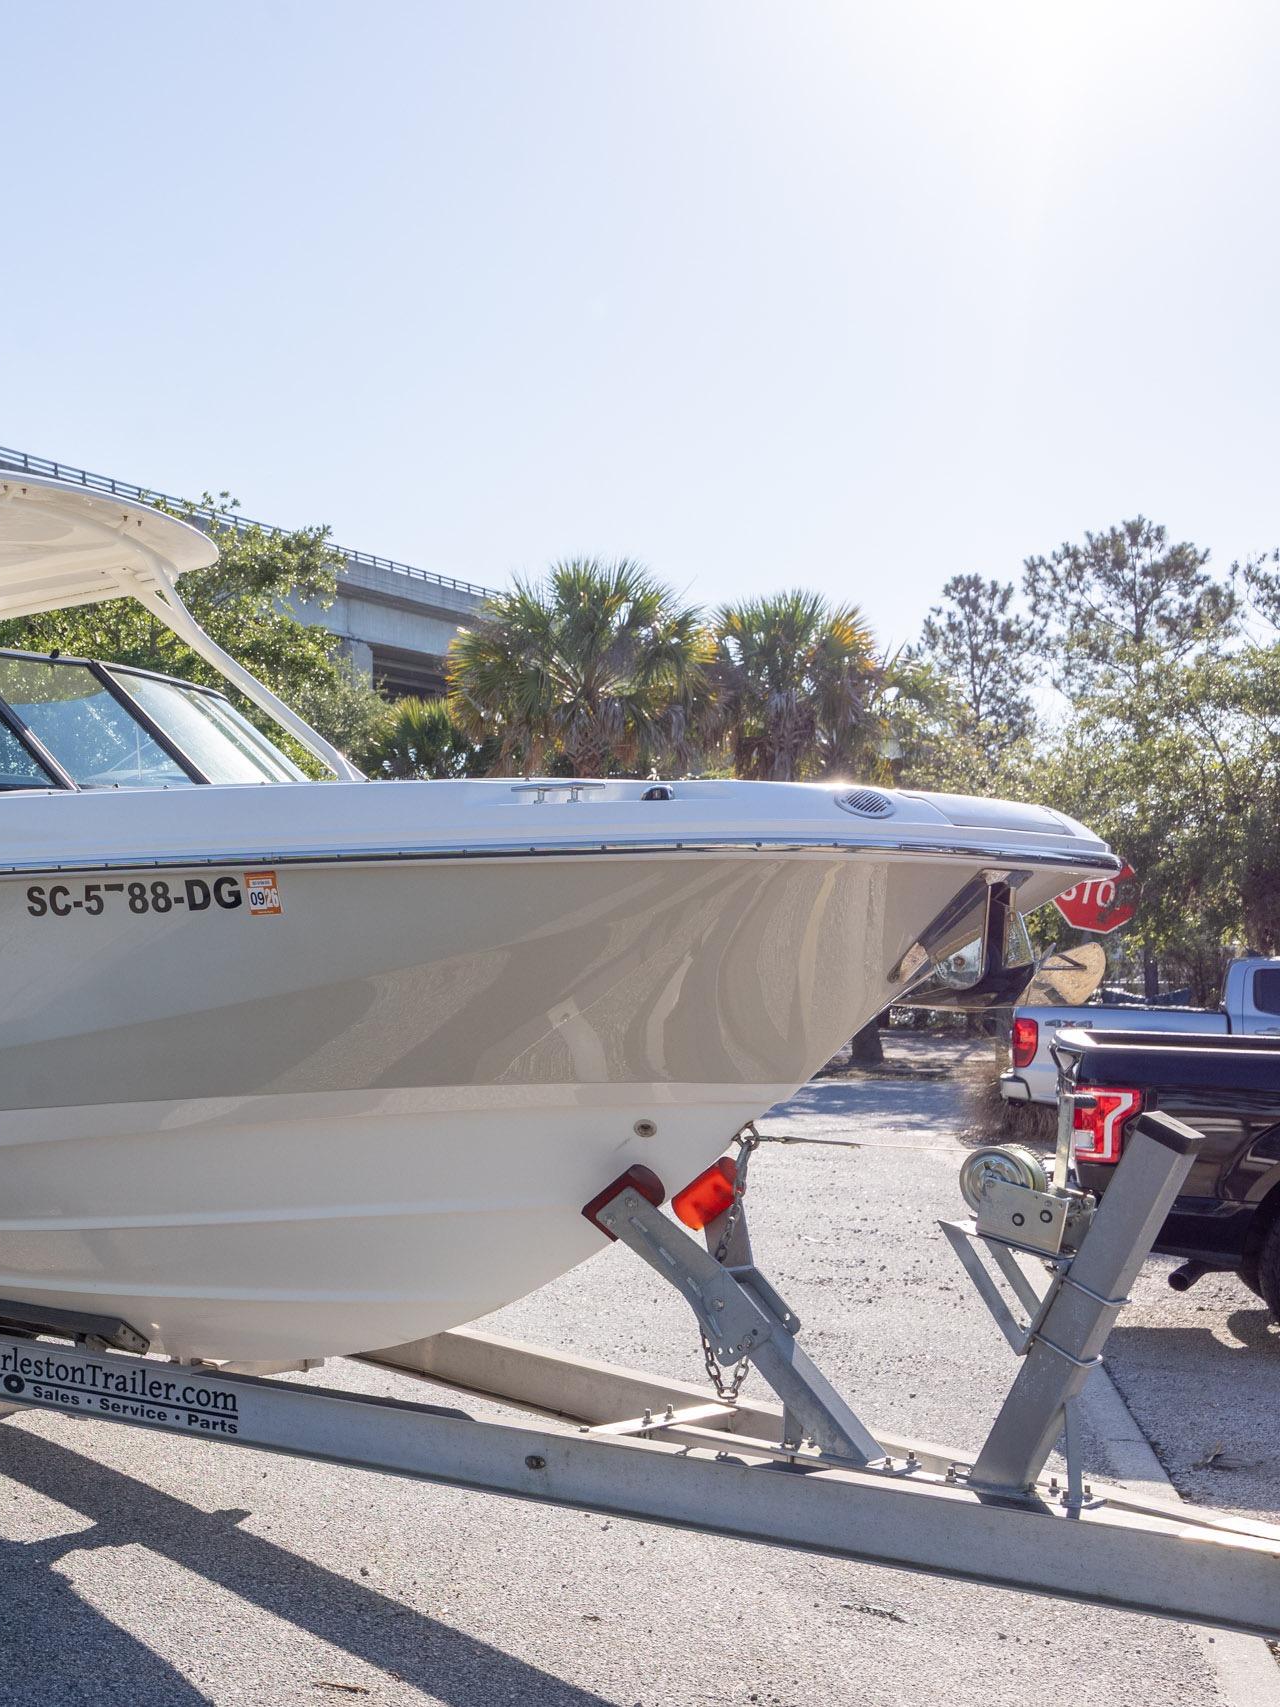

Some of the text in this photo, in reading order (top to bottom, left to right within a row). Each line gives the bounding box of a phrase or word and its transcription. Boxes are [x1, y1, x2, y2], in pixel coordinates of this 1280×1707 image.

[250, 891, 265, 906] 09
[1059, 879, 1121, 909] TO
[32, 1385, 239, 1435] Sales Service Parts
